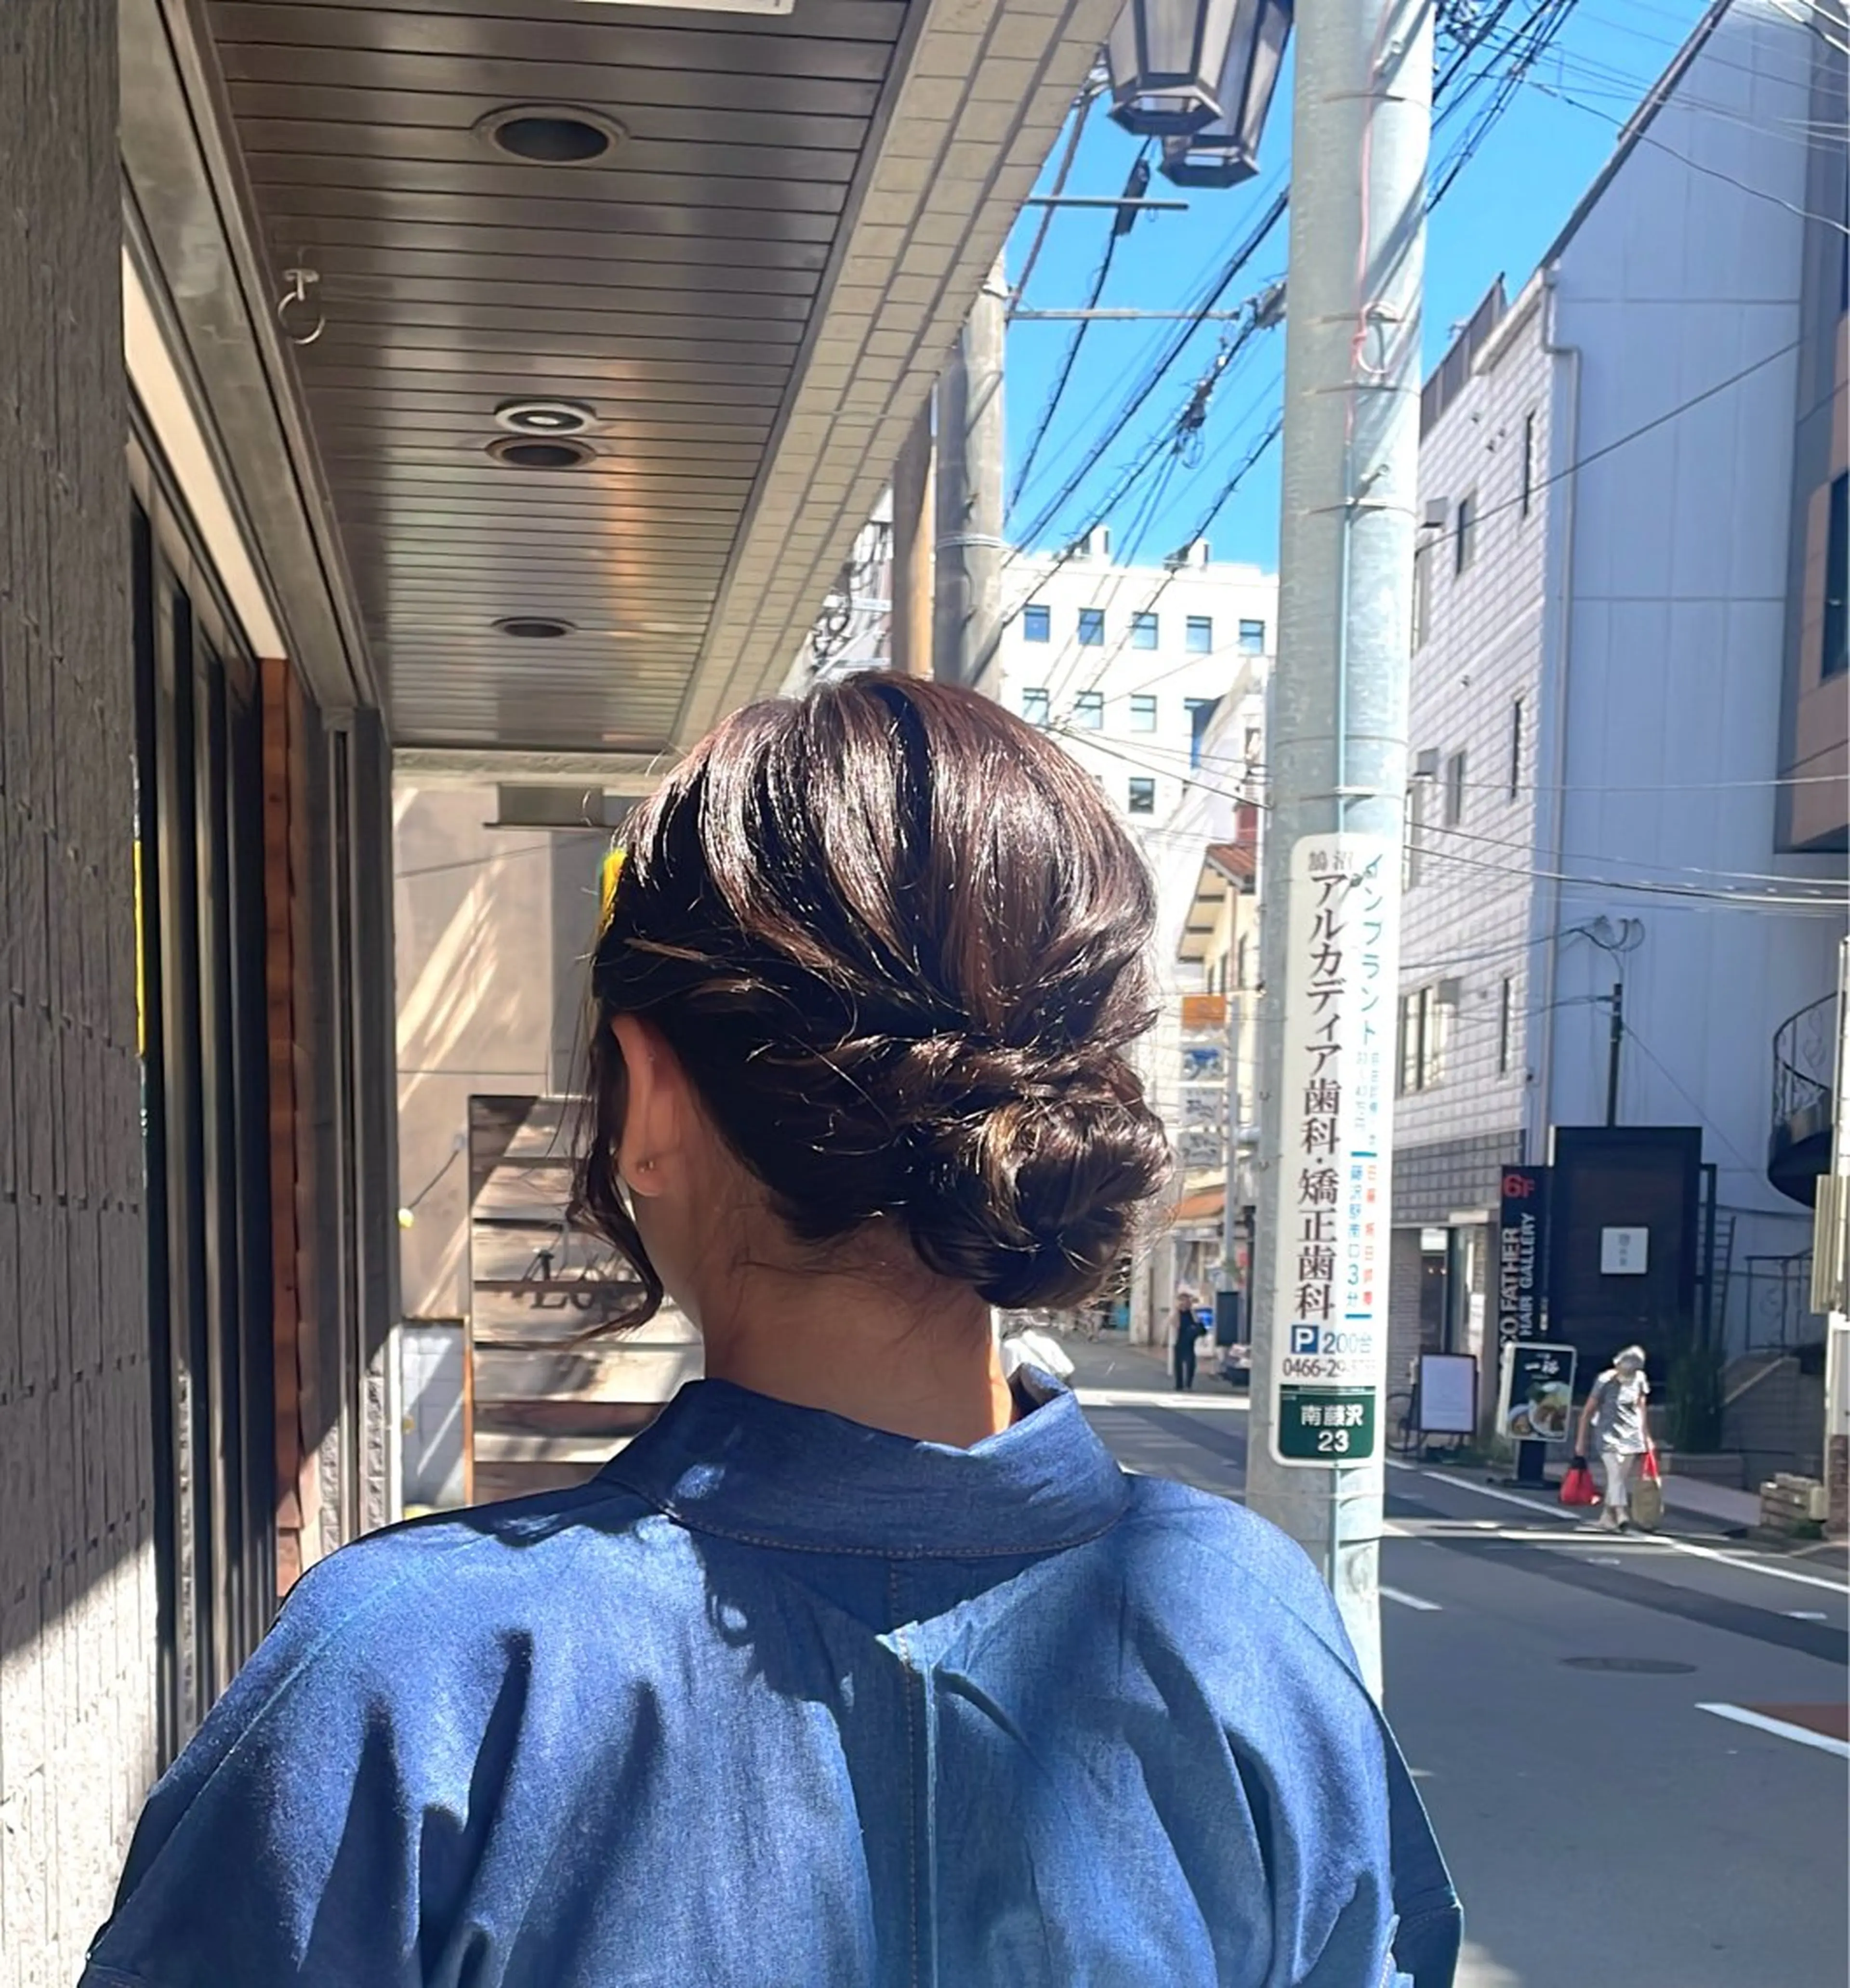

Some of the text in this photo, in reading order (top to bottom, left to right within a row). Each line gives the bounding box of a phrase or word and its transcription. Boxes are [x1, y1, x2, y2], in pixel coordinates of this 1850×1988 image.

[1504, 1174, 1535, 1198] 6F
[1501, 1228, 1521, 1311] FATHER
[1519, 1212, 1536, 1336] HAIR GALLERY
[1318, 1429, 1349, 1452] 23
